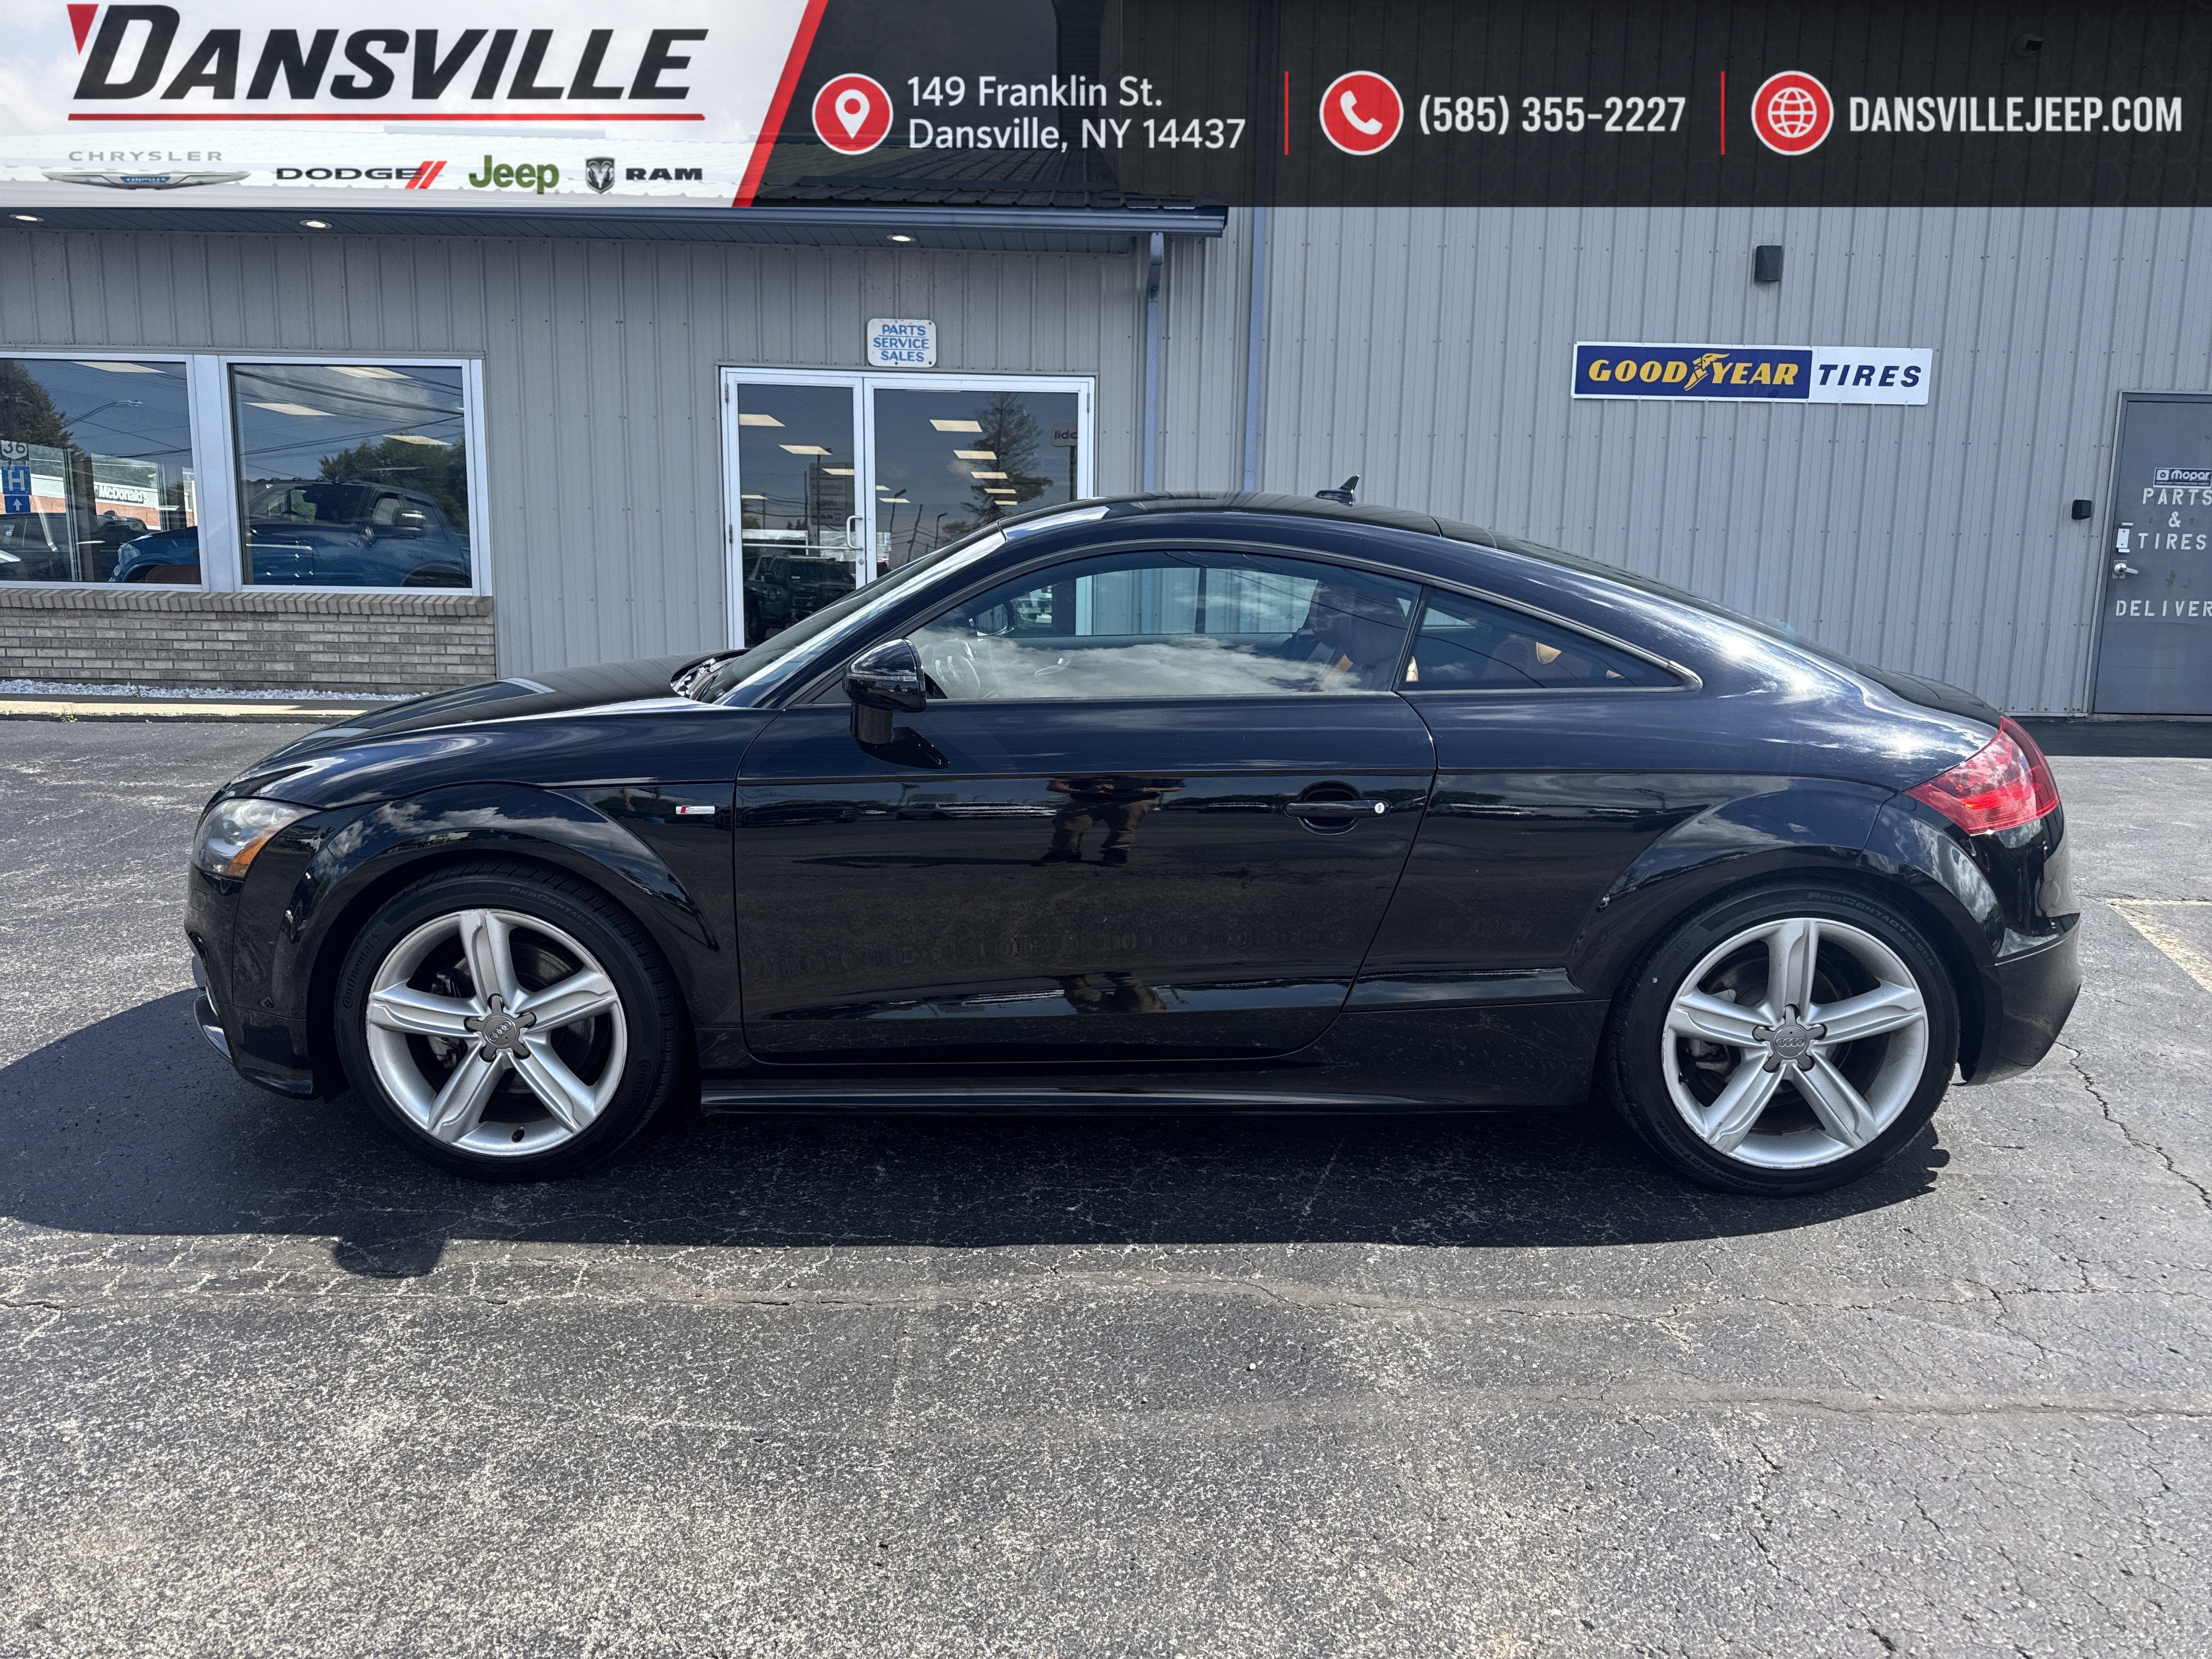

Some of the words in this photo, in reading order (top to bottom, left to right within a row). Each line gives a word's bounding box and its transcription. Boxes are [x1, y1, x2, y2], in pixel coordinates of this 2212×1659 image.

[882, 324, 926, 336] PARTS
[873, 337, 930, 349] SERVICE
[881, 351, 924, 362] SALES
[1819, 364, 1921, 387] TIRES
[8, 470, 25, 491] H
[99, 485, 149, 504] McDonald's
[2142, 487, 2212, 506] PARTS
[2168, 511, 2181, 528] &
[2138, 533, 2207, 550] TIRES
